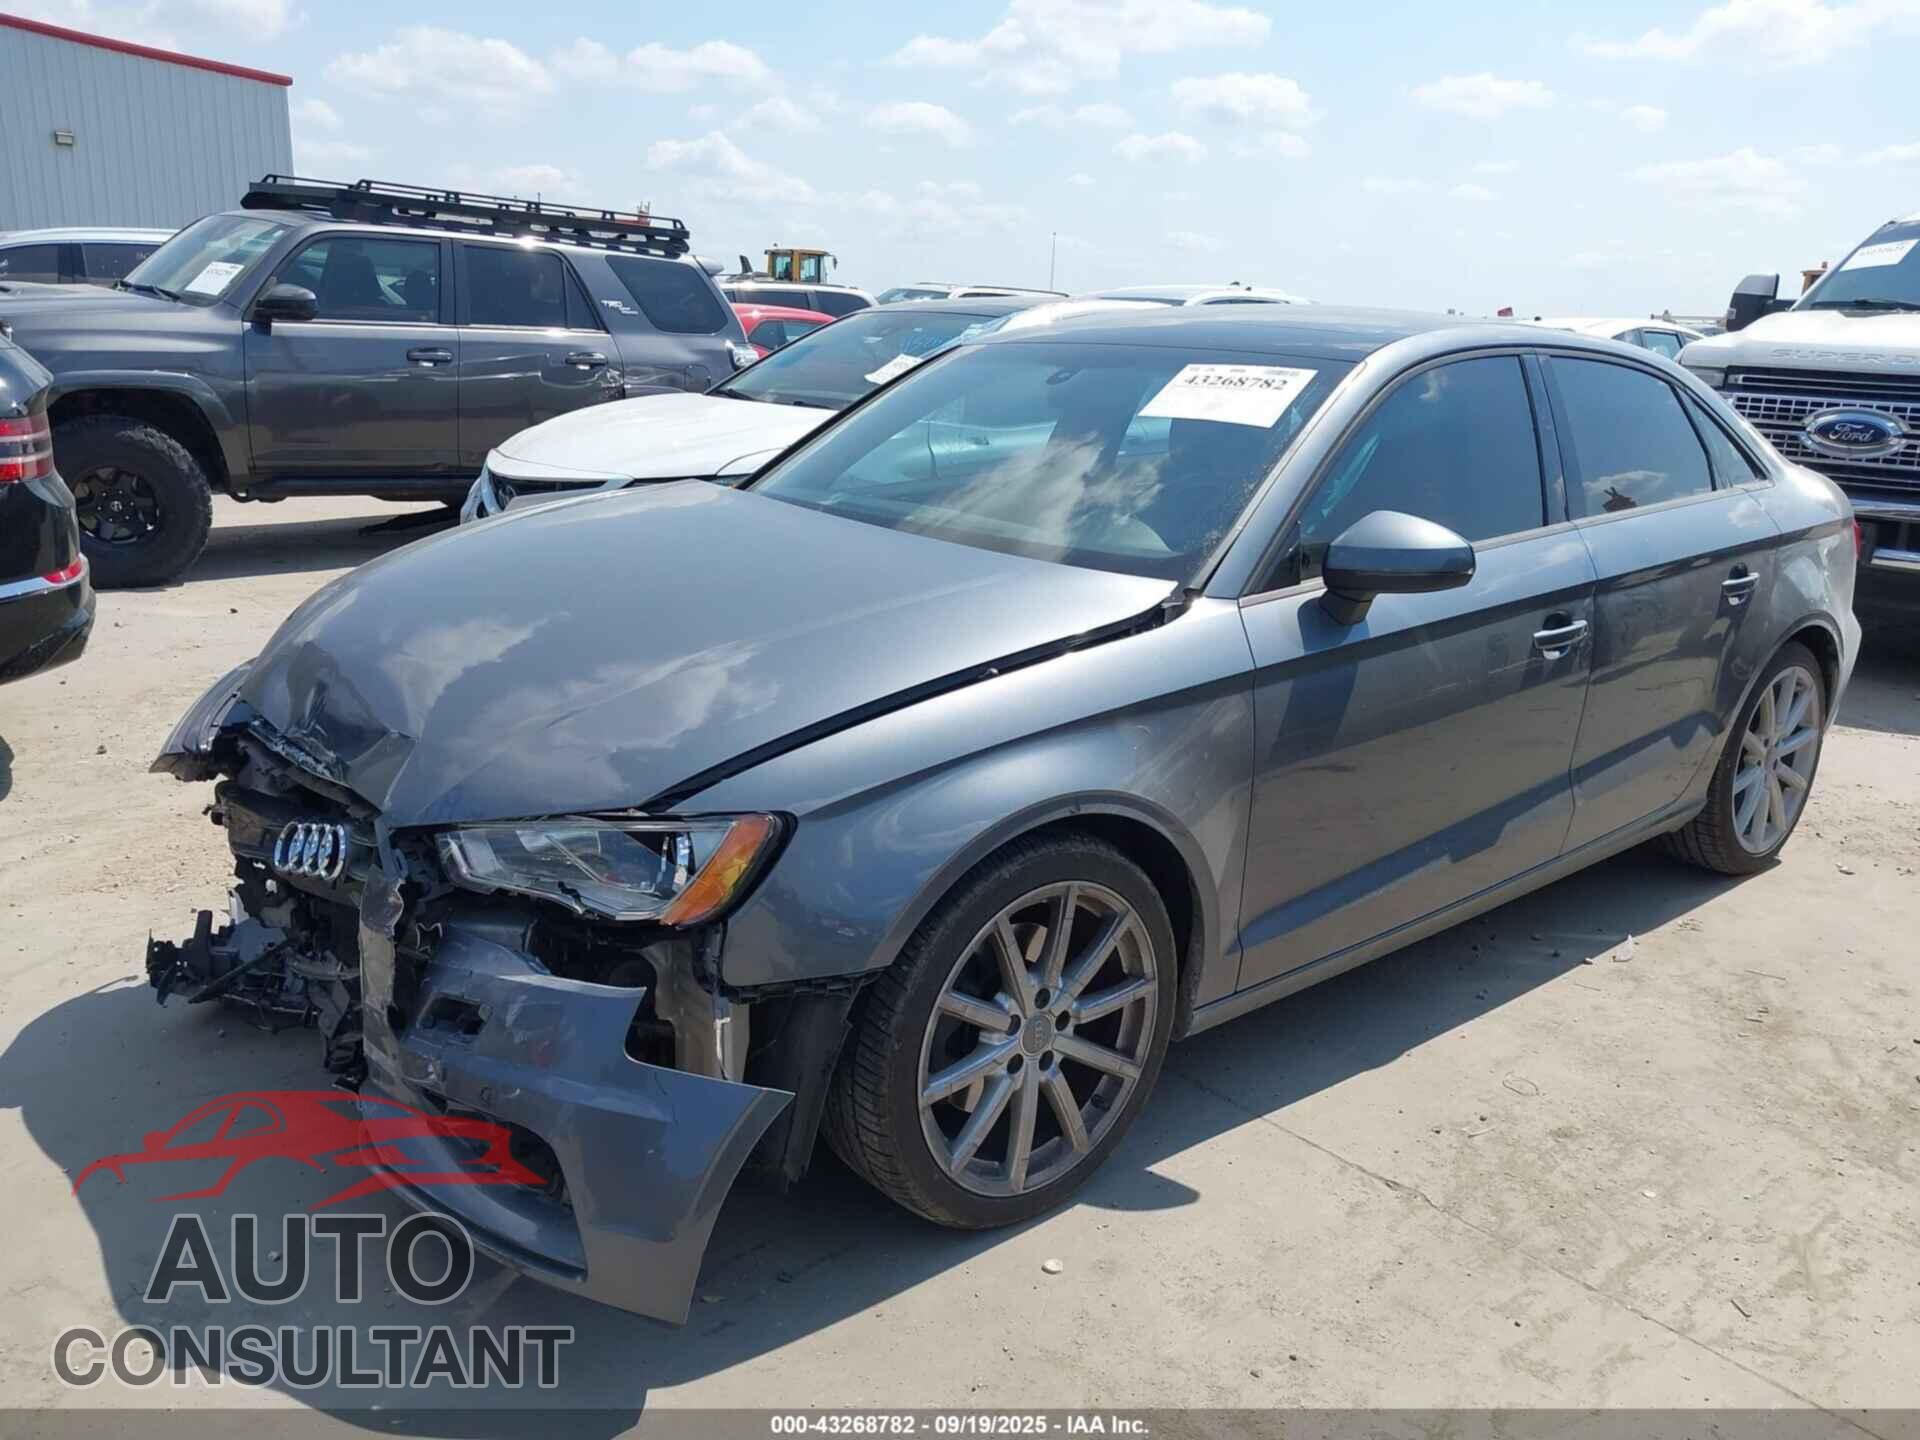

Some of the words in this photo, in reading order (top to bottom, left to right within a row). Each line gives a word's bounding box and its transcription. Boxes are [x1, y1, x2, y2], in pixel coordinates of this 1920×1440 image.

[1768, 348, 1885, 365] SUPER
[1184, 375, 1289, 391] 43268782
[1828, 422, 1873, 443] Ford
